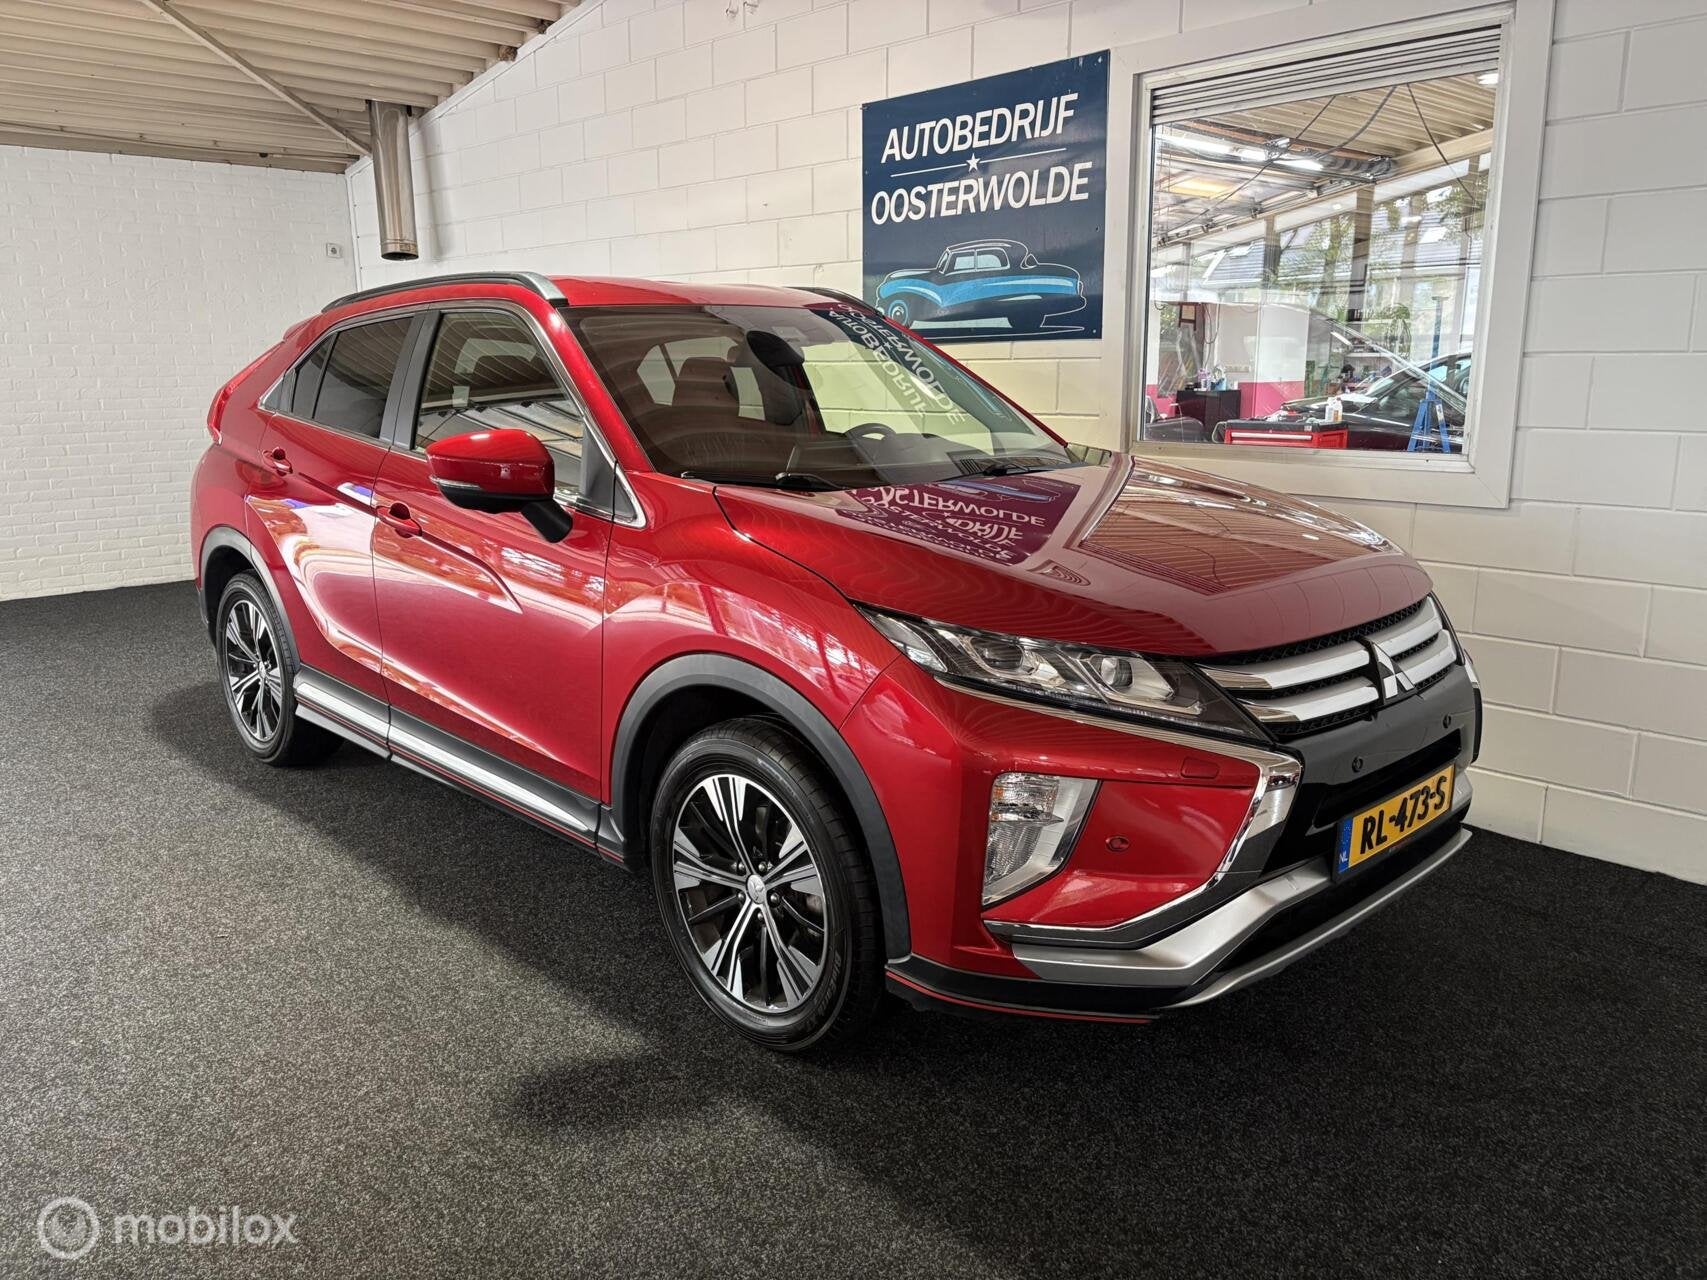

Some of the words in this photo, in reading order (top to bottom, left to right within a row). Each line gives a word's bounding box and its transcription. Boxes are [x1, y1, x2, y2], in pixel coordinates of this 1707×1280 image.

[880, 92, 1079, 164] AUTOBEDRIJF
[871, 161, 1093, 225] OOSTERWOLDE
[1359, 775, 1448, 855] RL-473-S
[1338, 850, 1348, 864] NL
